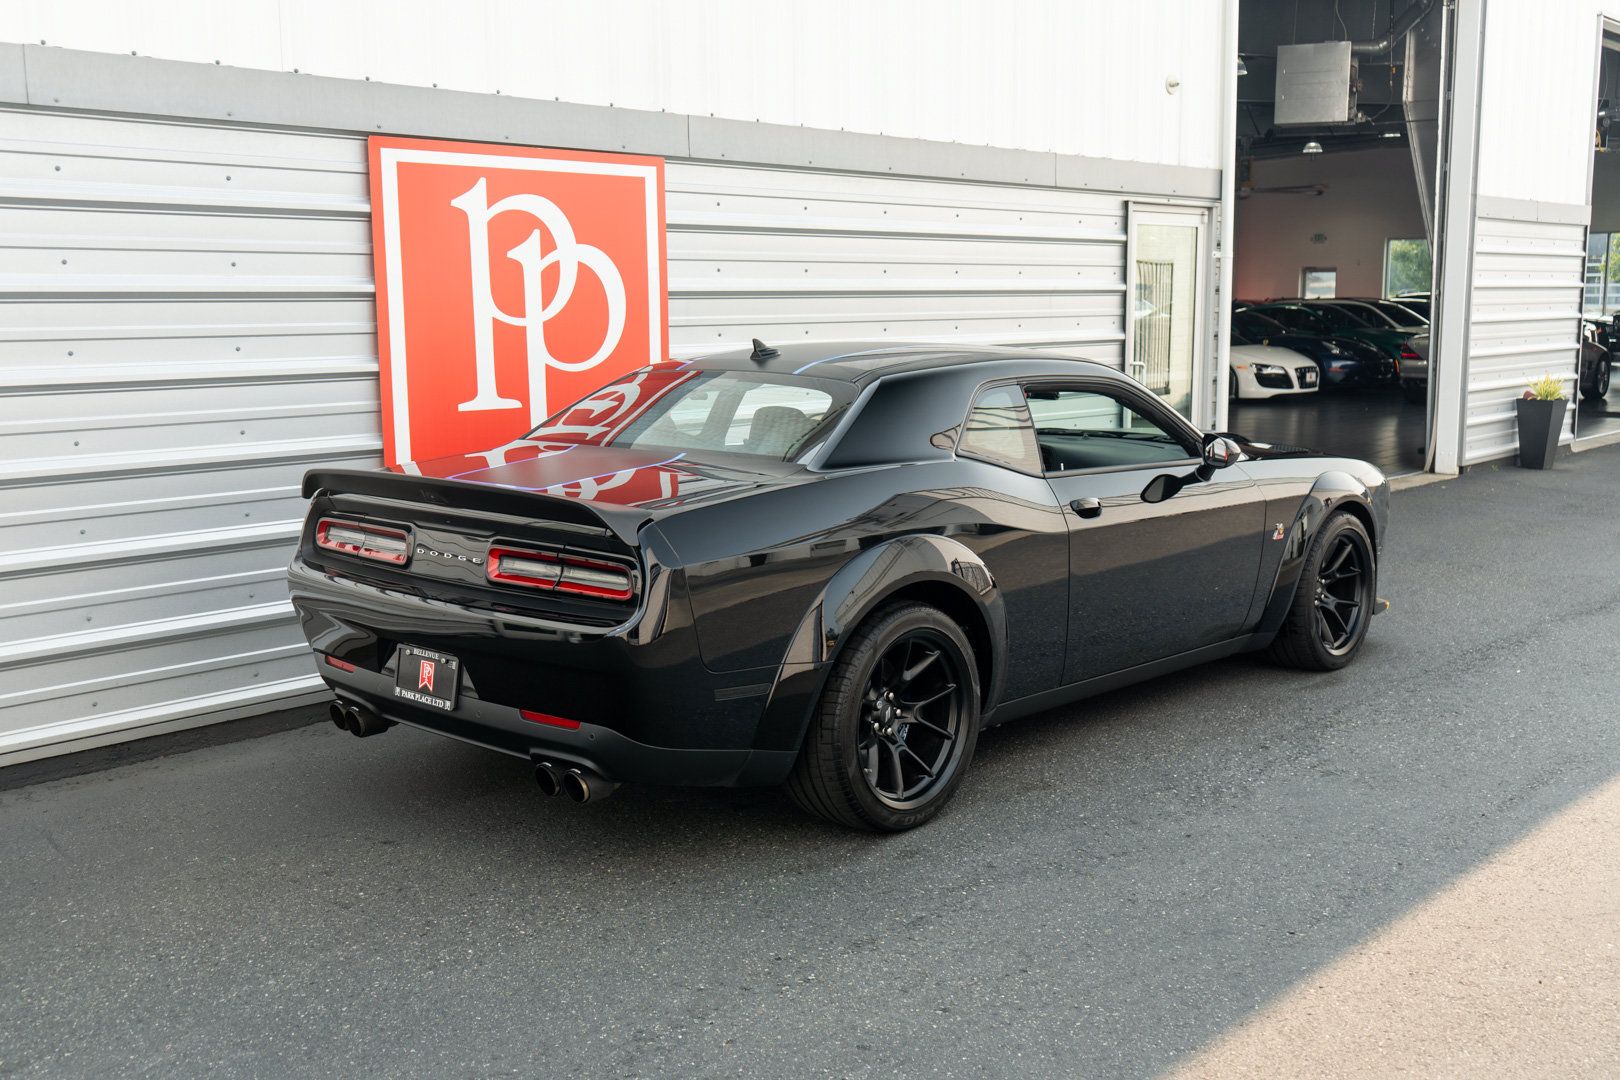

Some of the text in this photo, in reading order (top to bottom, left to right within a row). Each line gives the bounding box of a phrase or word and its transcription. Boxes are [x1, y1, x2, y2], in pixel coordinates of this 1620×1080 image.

[416, 548, 482, 564] DODGE
[413, 648, 439, 660] BELLEVUE
[401, 690, 415, 700] PARK
[415, 693, 432, 705] PLACE
[432, 698, 444, 708] LTD
